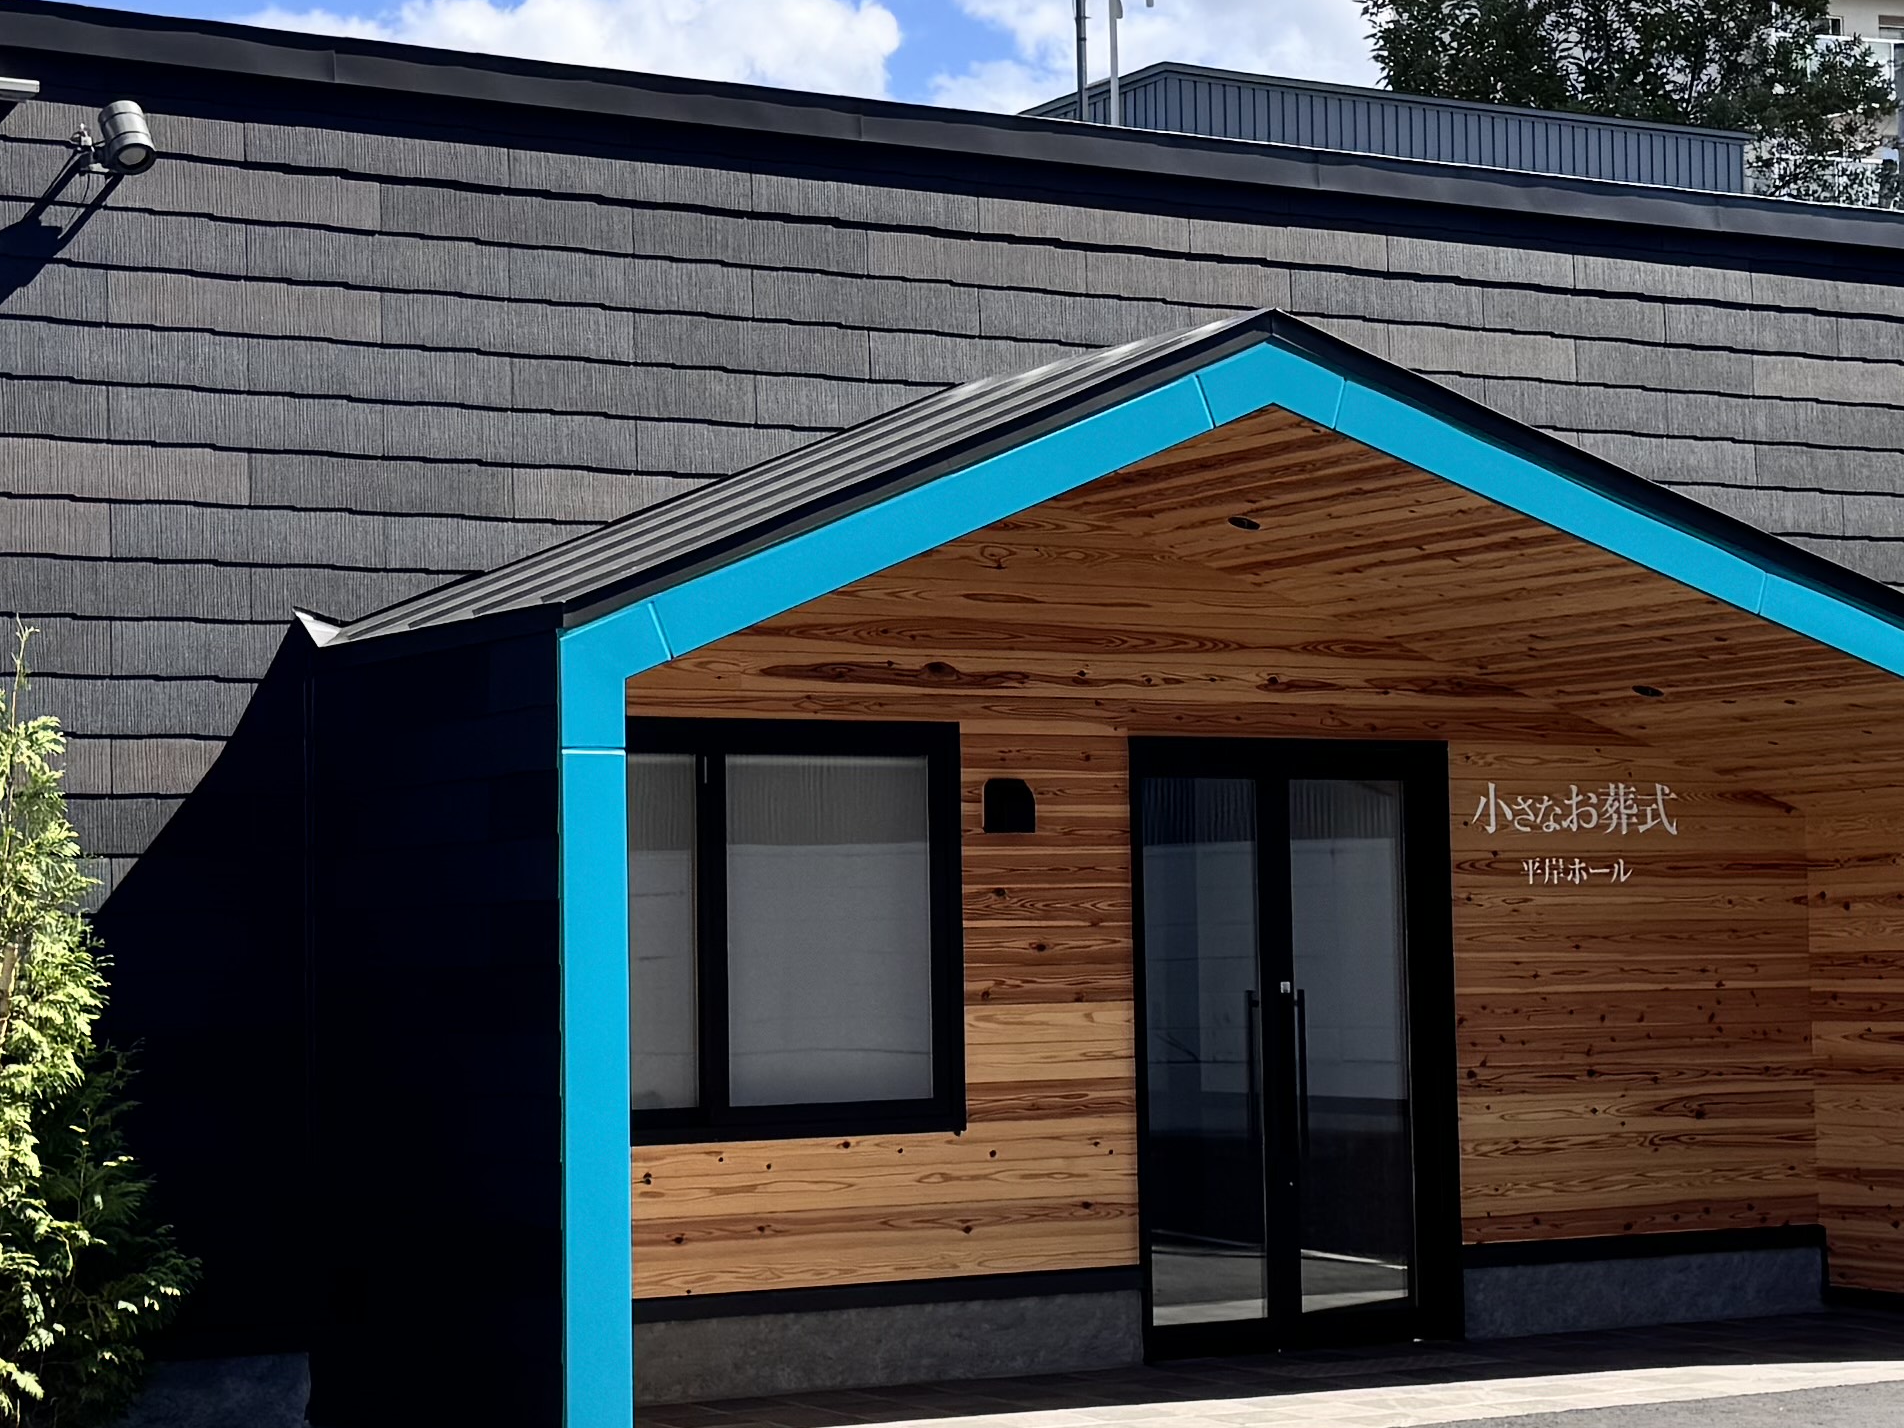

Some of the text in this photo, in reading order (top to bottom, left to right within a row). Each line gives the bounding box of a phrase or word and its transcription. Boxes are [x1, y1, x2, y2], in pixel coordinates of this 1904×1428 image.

[1472, 781, 1679, 836] 小さなお葬式
[1520, 857, 1633, 885] 平岸ホール
